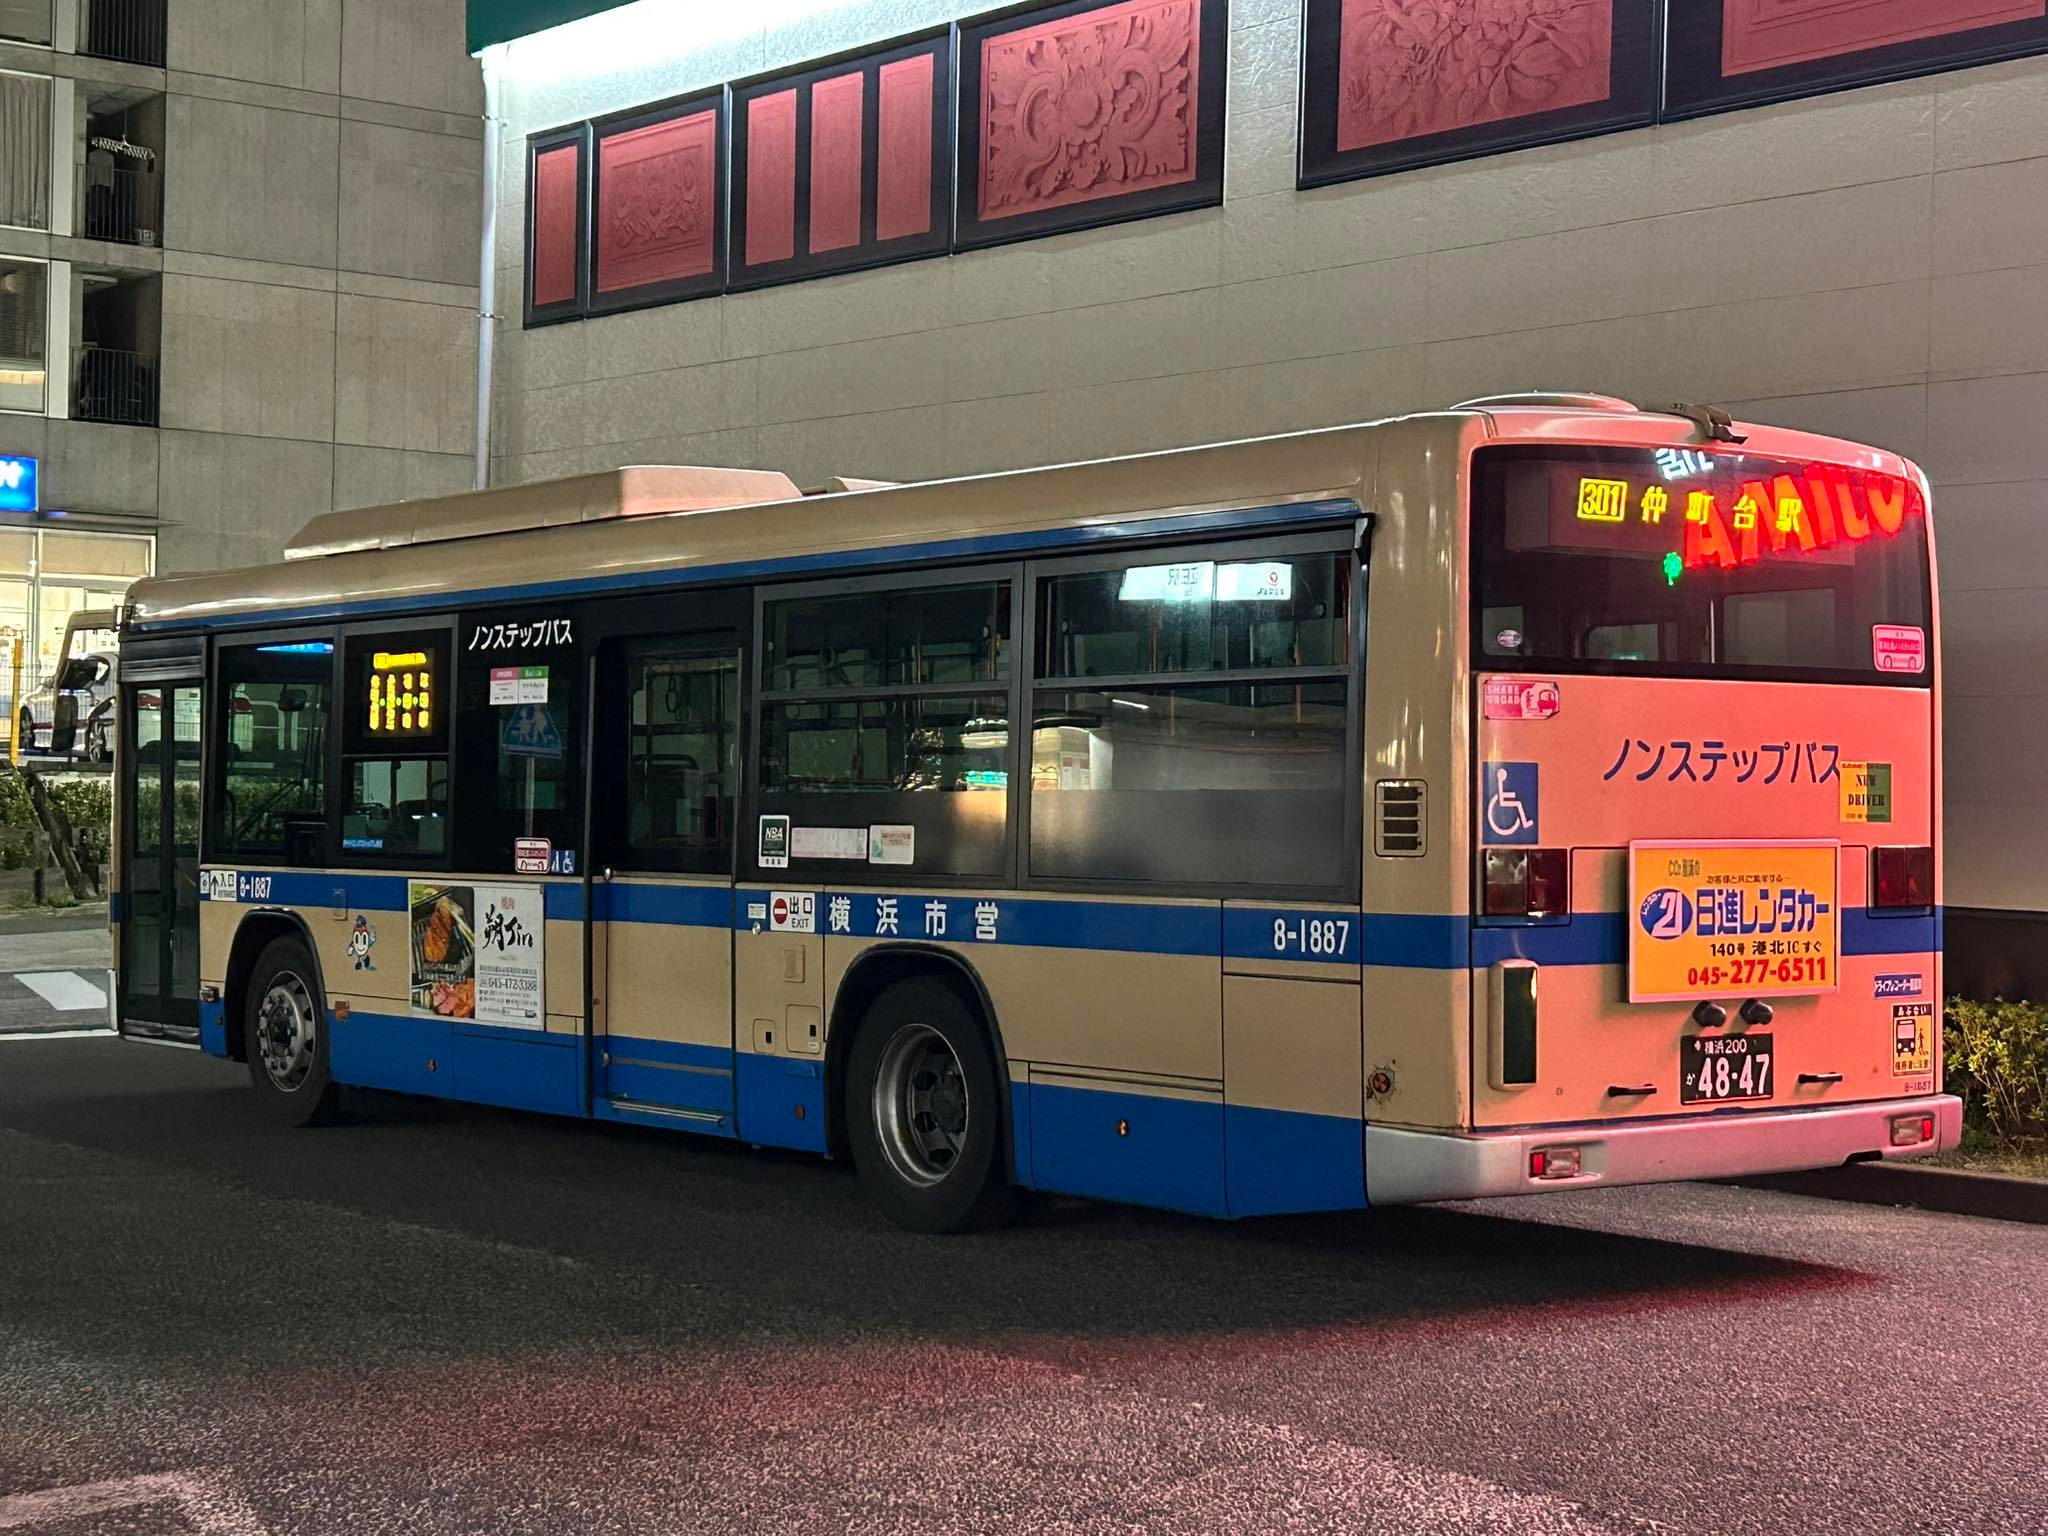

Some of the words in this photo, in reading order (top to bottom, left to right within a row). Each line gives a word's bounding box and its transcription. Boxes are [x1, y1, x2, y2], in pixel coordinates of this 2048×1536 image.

[1582, 483, 1619, 517] 301
[1640, 485, 1802, 533] 仲町台駅
[468, 619, 573, 651] ノンステップバス
[1603, 738, 1840, 784] ノンステップバス
[219, 873, 234, 887] 入口
[240, 876, 272, 899] 8-1887
[789, 896, 813, 915] 出口
[829, 896, 998, 940] 横浜市営
[1696, 888, 1829, 936] 日進レンタカー
[791, 917, 810, 928] EXIT
[1274, 918, 1349, 955] 8-1887
[1710, 942, 1745, 957] 140号
[1688, 957, 1826, 986] 045-277-6511
